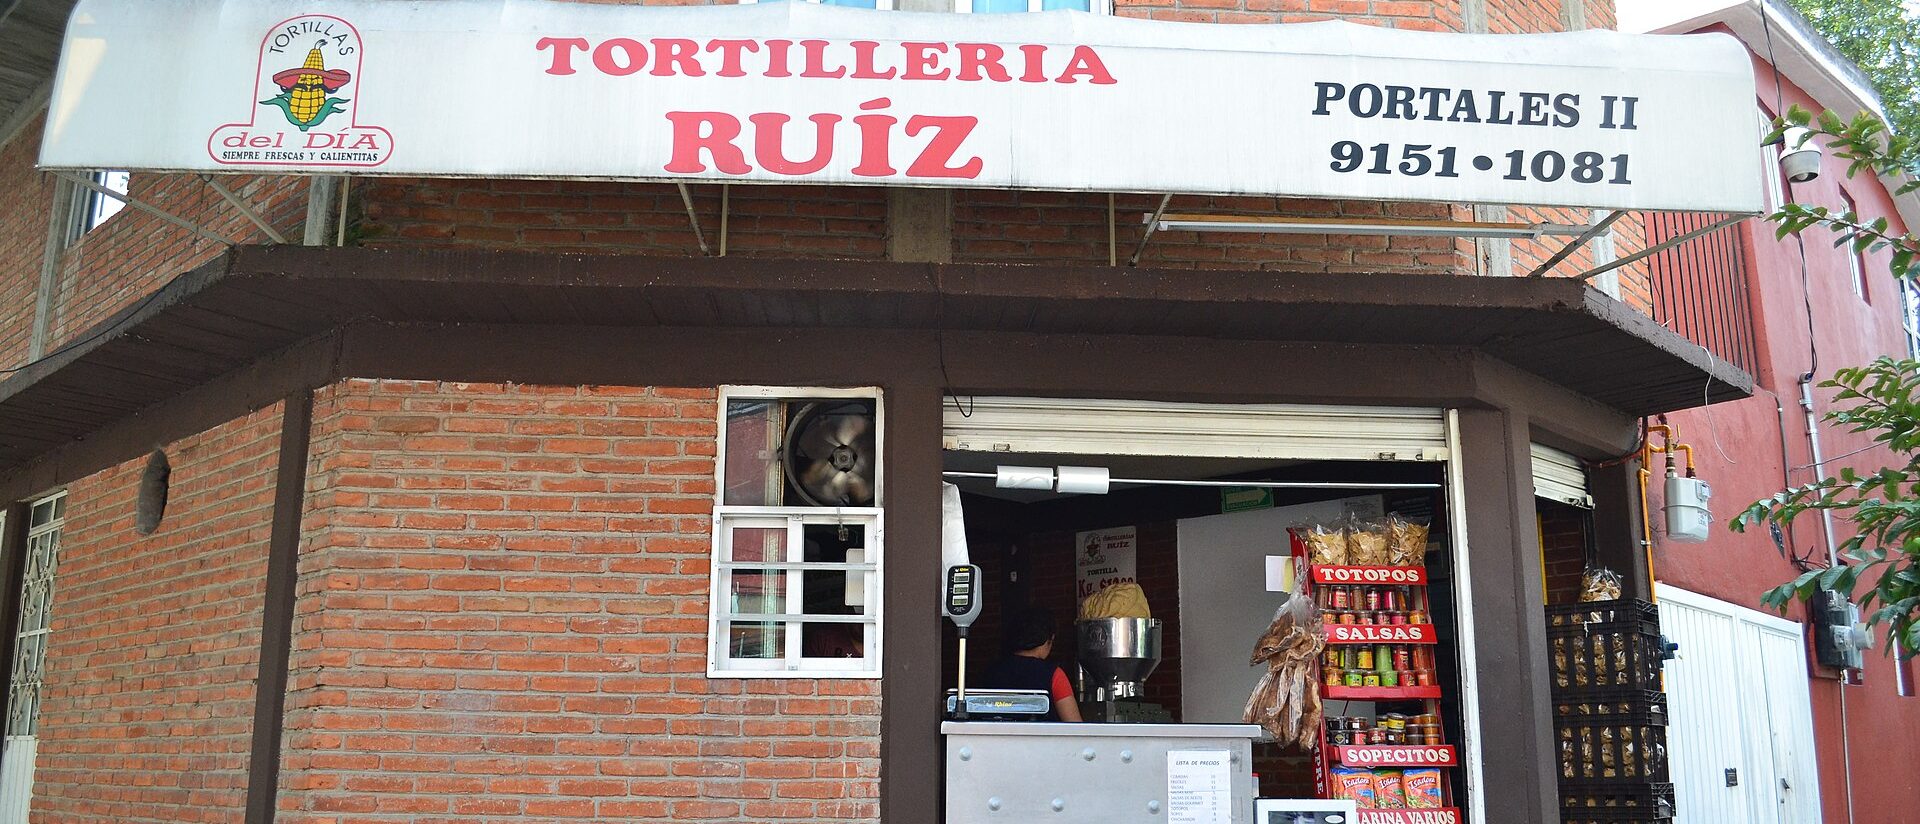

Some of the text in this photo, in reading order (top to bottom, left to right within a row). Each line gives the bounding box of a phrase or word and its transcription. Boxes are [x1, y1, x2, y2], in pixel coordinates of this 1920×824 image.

[269, 21, 354, 56] TORTILLAS
[536, 37, 1117, 84] TORTILLERIA
[1312, 82, 1638, 129] PORTALES II
[223, 127, 379, 149] del DÍA
[664, 97, 983, 178] RUÍZ
[222, 151, 378, 161] SIEMPRE FRESCAS Y CALIENTITAS
[1320, 568, 1419, 582] TOTOPOS
[1336, 627, 1422, 641] SALSAS
[1347, 748, 1450, 763] SOPECITOS
[1357, 810, 1455, 824] ARINA VARIOS
